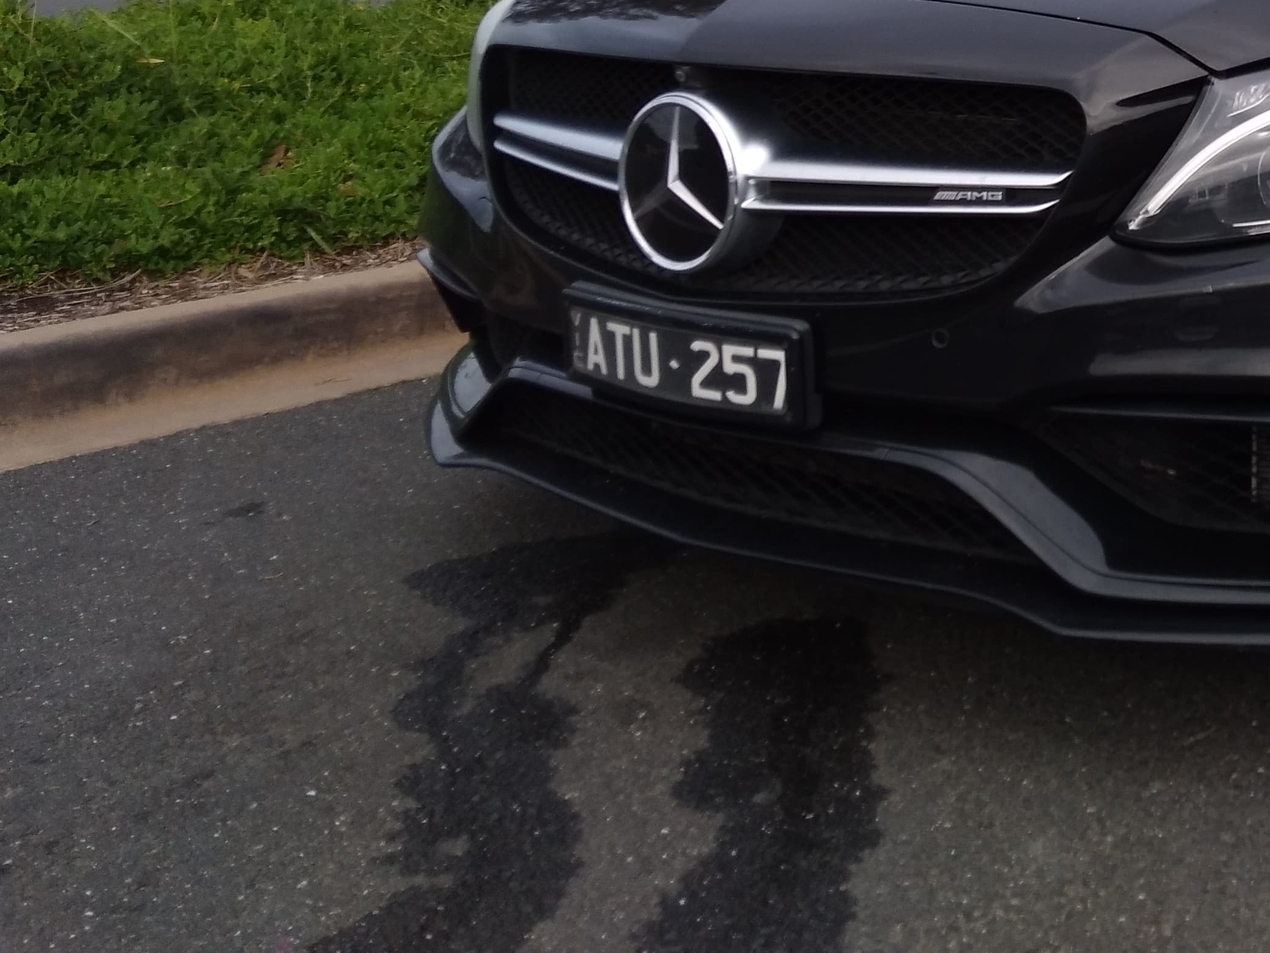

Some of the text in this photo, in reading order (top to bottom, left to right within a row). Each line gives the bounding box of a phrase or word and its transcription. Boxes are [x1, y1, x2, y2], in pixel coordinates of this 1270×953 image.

[955, 191, 1003, 201] AMG
[587, 316, 787, 411] ATU 257
